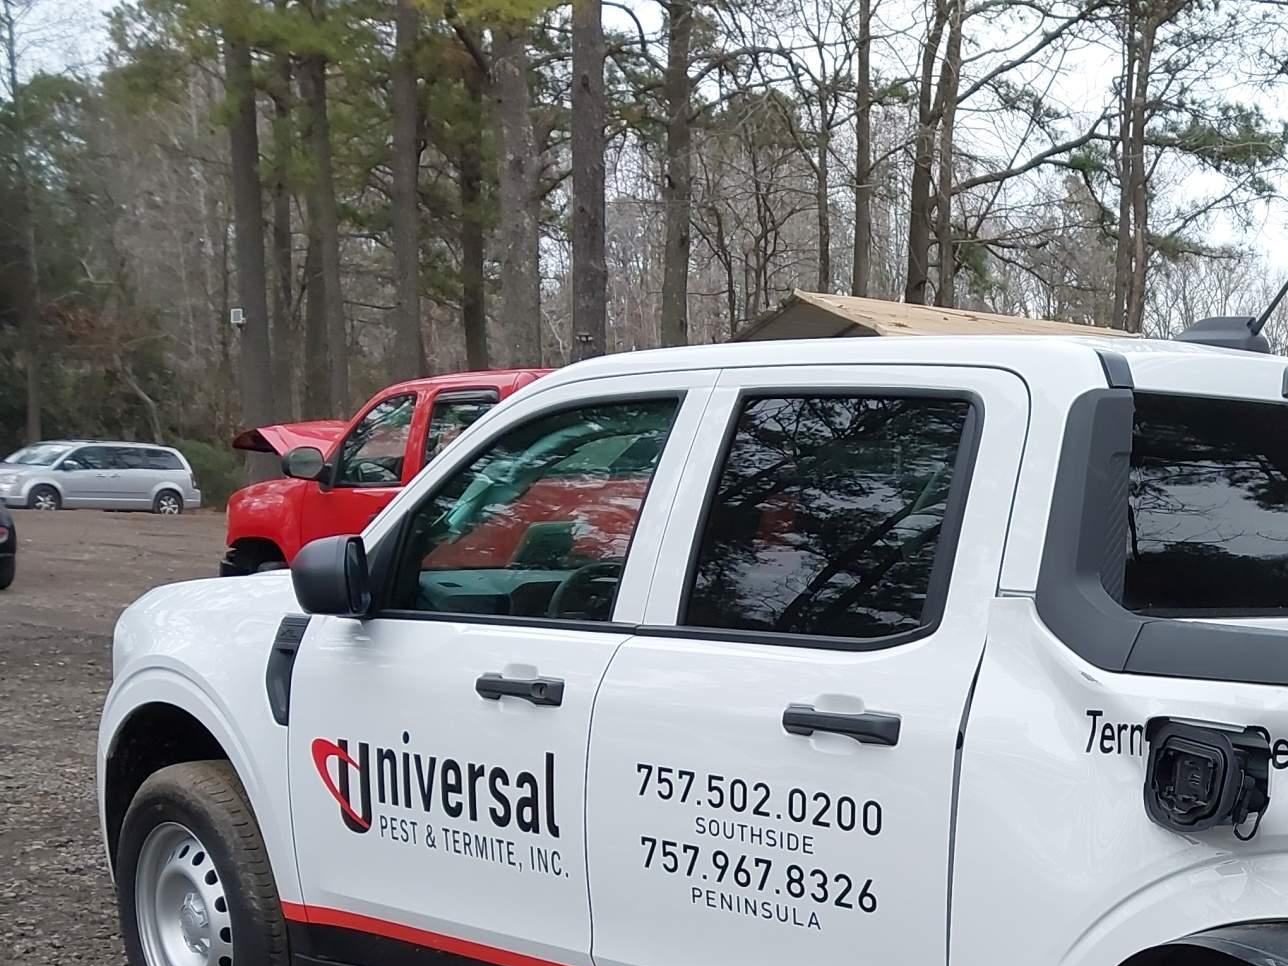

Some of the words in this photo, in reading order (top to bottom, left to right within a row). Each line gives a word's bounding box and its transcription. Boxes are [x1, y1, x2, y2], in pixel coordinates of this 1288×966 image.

[1085, 709, 1145, 756] Term
[314, 730, 560, 839] Universal
[636, 763, 882, 836] 757.502.0200
[379, 815, 418, 845] PEST
[425, 824, 437, 849] &
[441, 827, 524, 873] TERMITE,
[530, 846, 570, 878] INC.
[695, 816, 815, 855] SOUTHSIDE
[640, 836, 877, 913] 757.967.8326
[691, 887, 822, 931] PENINSULA
